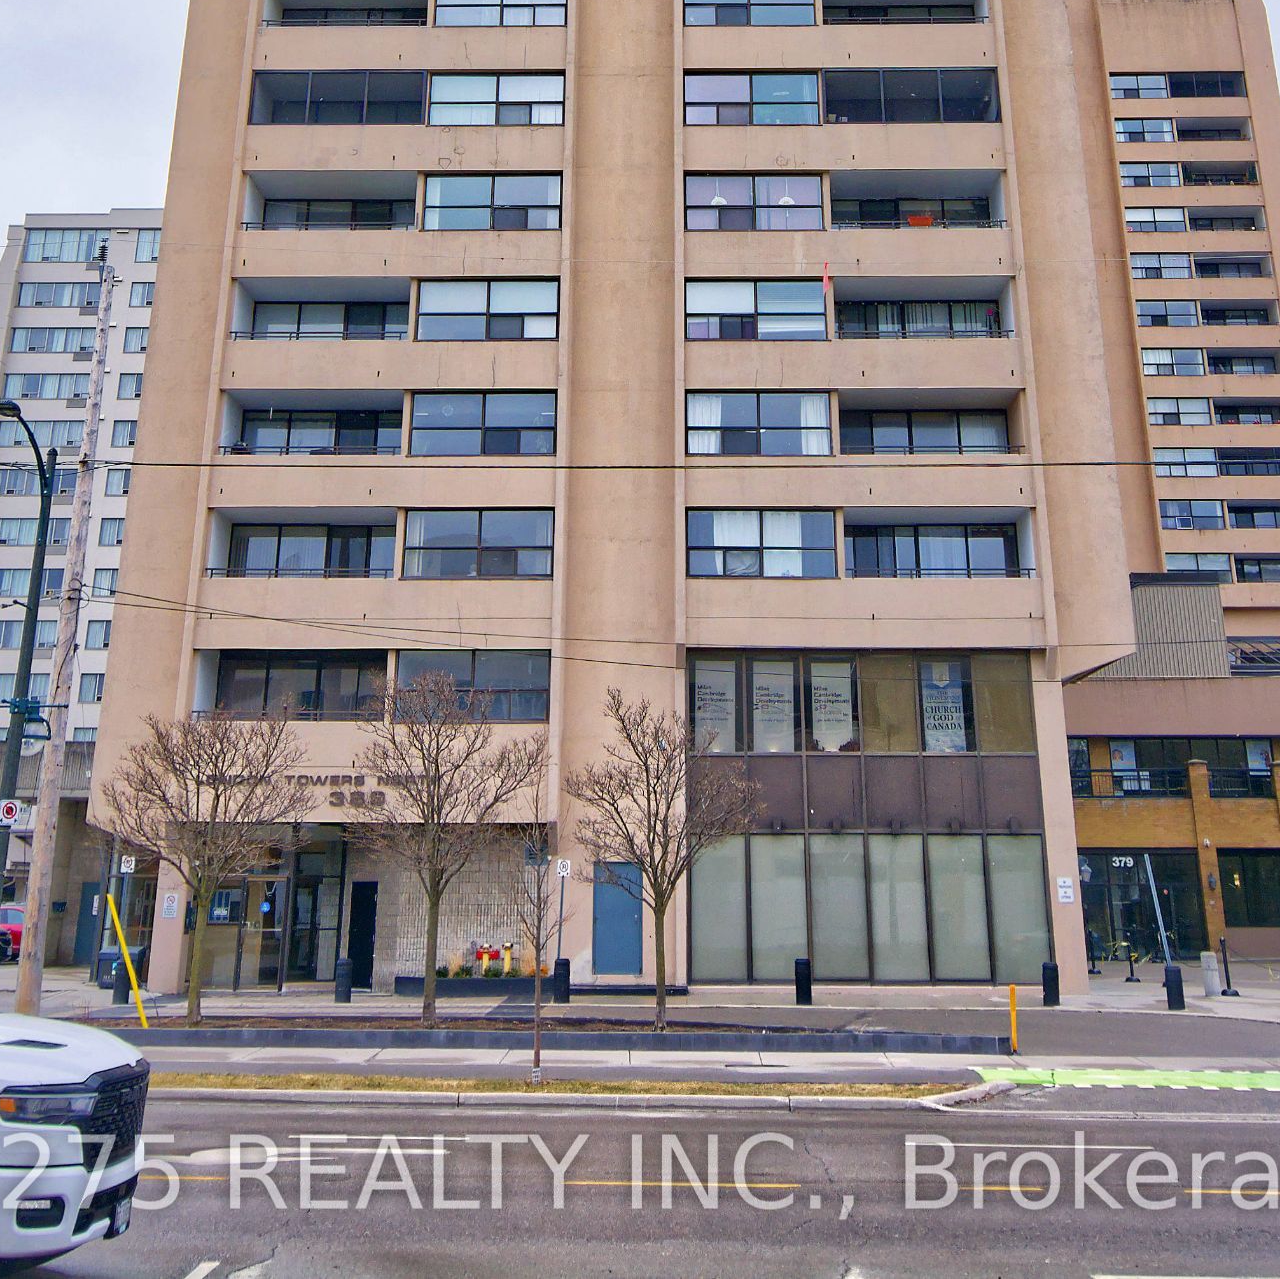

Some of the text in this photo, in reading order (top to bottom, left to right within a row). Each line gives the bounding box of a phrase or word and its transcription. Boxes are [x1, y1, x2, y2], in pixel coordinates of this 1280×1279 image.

[925, 706, 961, 714] CHURCH
[926, 722, 962, 730] CANADA
[284, 774, 365, 787] TOWERS
[1111, 856, 1134, 868] 379
